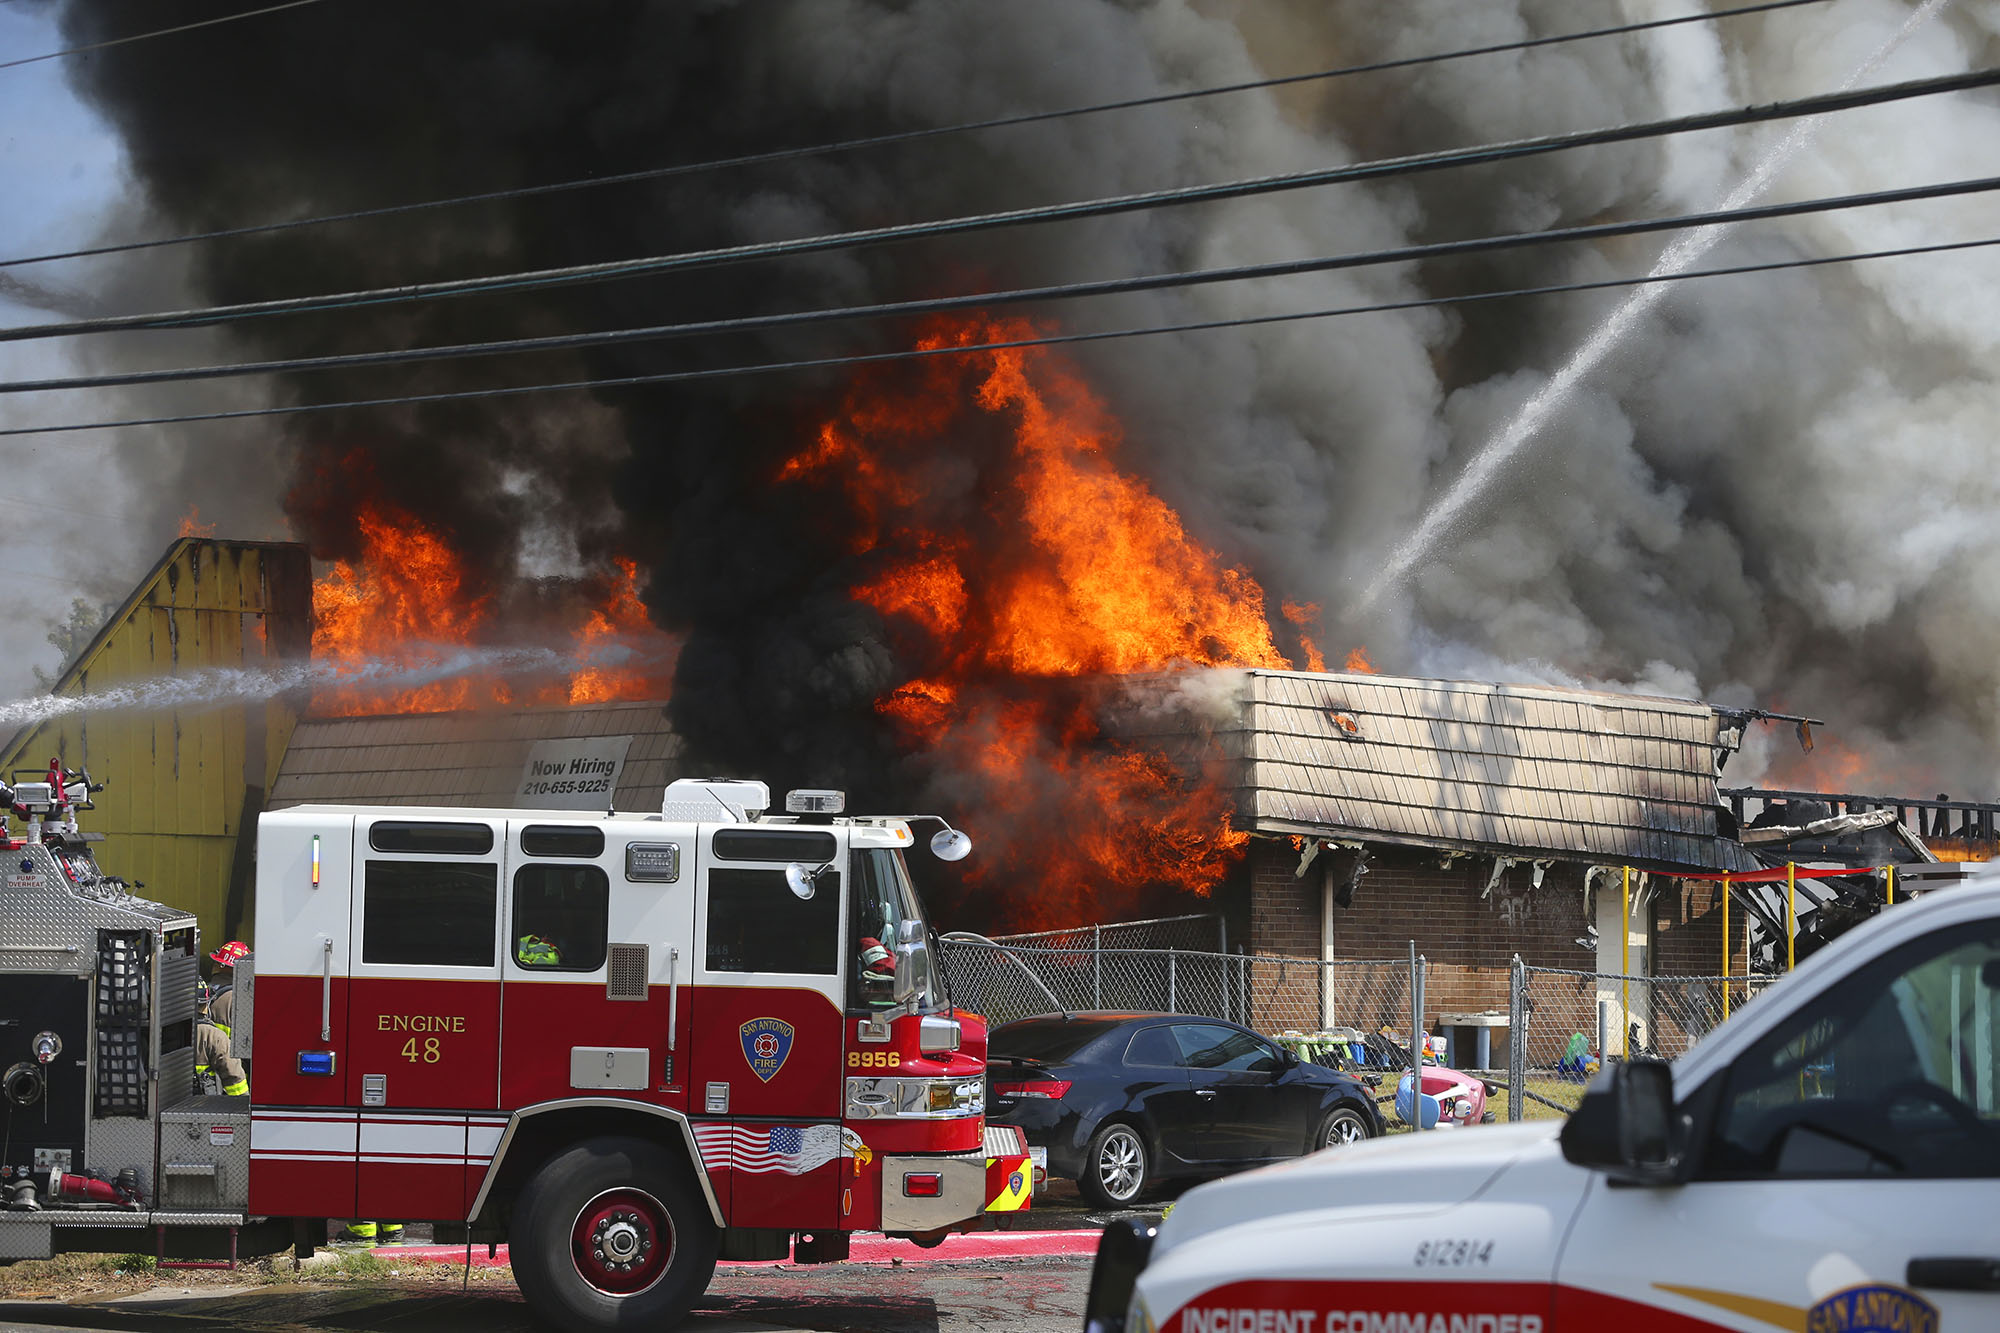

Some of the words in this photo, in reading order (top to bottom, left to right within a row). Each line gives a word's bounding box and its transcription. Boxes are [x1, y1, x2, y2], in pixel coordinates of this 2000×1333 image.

[531, 760, 566, 776] Now
[569, 758, 616, 776] Hiring
[523, 779, 610, 795] 210-655-9225
[377, 1015, 465, 1032] ENGINE
[742, 1022, 758, 1036] SAN
[759, 1020, 792, 1037] ANTONIO
[401, 1037, 441, 1063] 48
[754, 1058, 778, 1068] FIRE
[848, 1051, 900, 1068] 8956
[1414, 1239, 1494, 1268] 812814
[1182, 1307, 1316, 1333] INCIDENT
[1325, 1310, 1543, 1333] COMMANDER
[1811, 1297, 1849, 1333] SAN
